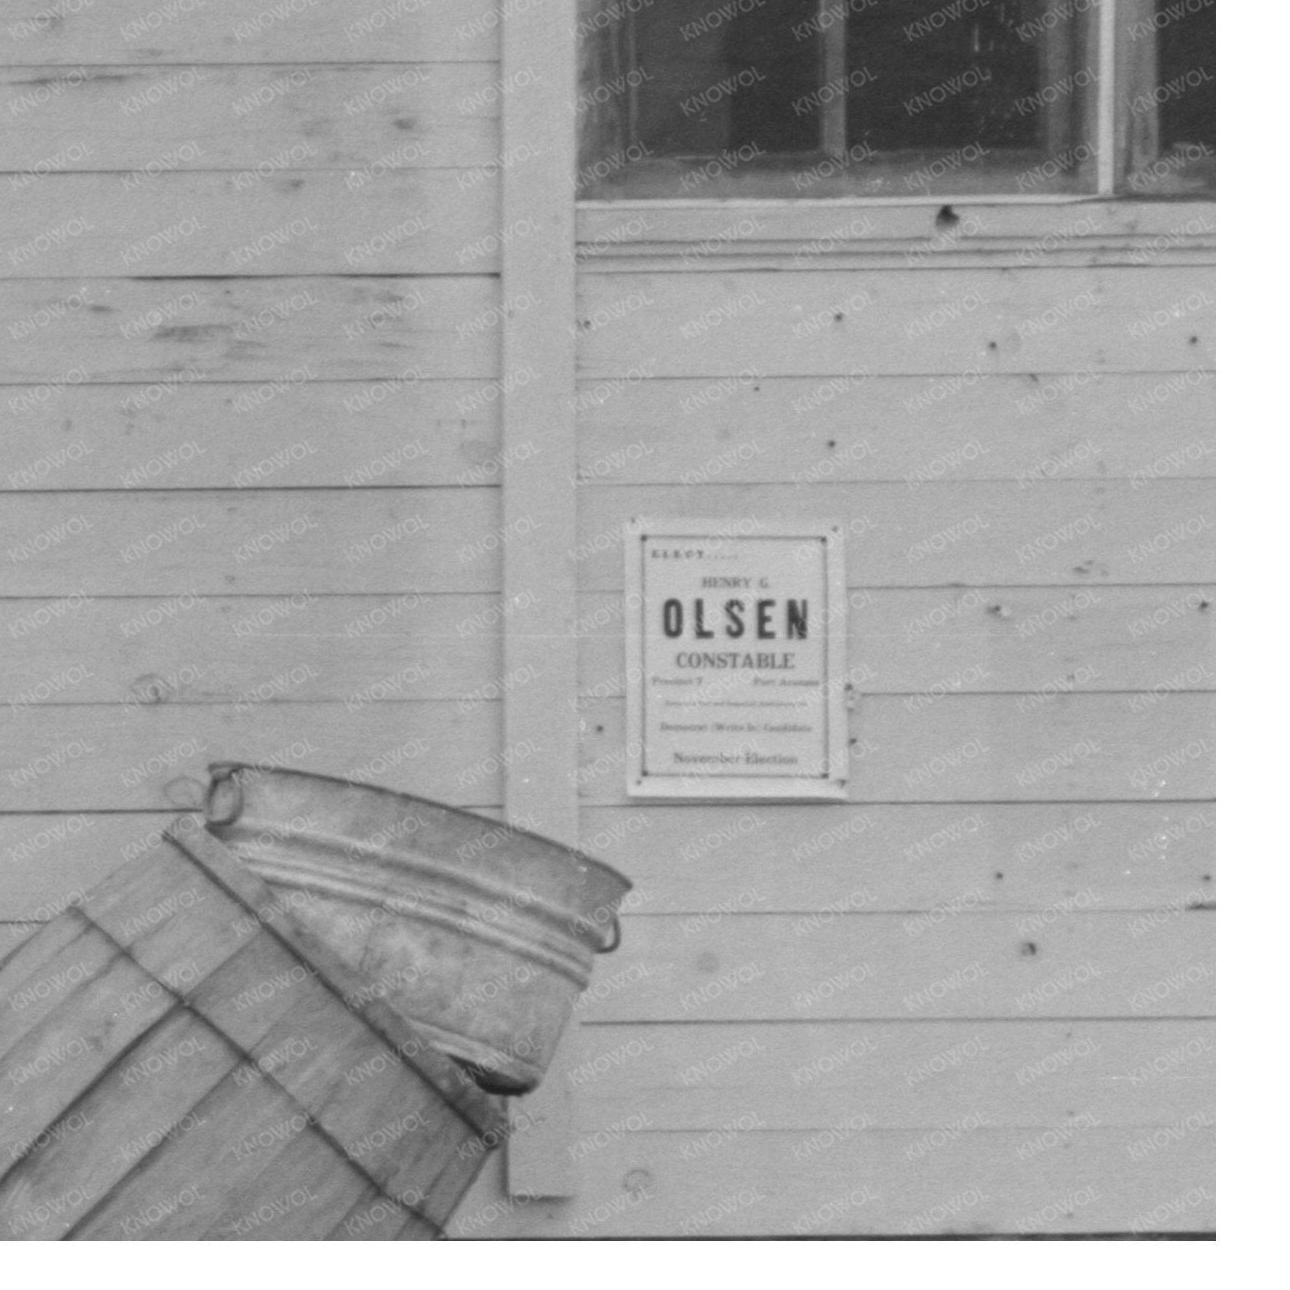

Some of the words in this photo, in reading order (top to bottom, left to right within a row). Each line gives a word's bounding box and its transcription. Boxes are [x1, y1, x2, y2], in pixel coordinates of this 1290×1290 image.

[701, 577, 752, 589] HENRY
[663, 598, 809, 640] OLSEN
[676, 652, 796, 669] CONSTABLE
[674, 752, 740, 764] November
[745, 752, 798, 764] Election
